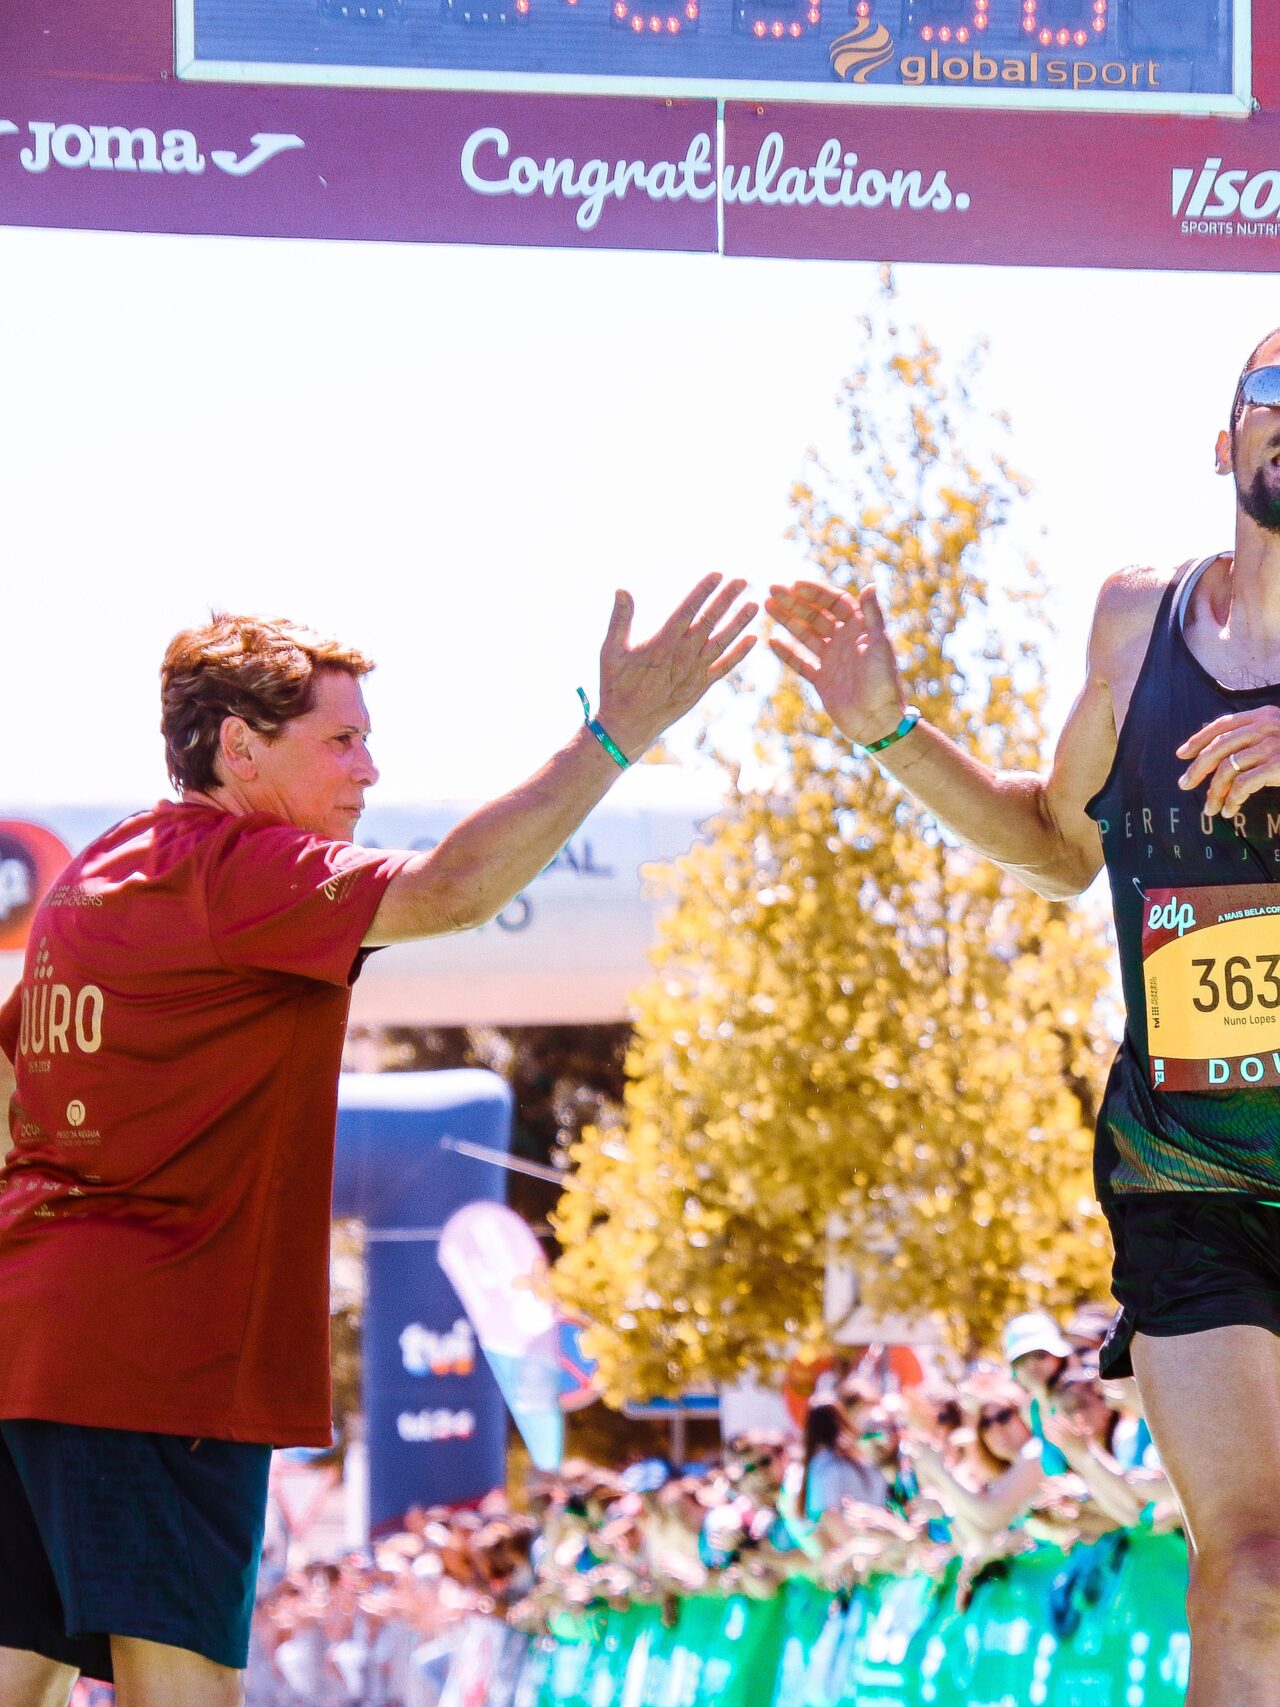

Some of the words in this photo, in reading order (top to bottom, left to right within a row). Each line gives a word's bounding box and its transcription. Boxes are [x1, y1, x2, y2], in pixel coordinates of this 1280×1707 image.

[1181, 220, 1234, 235] SPORTS
[1148, 896, 1197, 937] edp
[1217, 914, 1225, 923] A
[1225, 910, 1244, 921] MAIS
[1244, 907, 1265, 917] BELA
[1223, 1016, 1247, 1026] Nuno
[1249, 1014, 1277, 1027] Lopes
